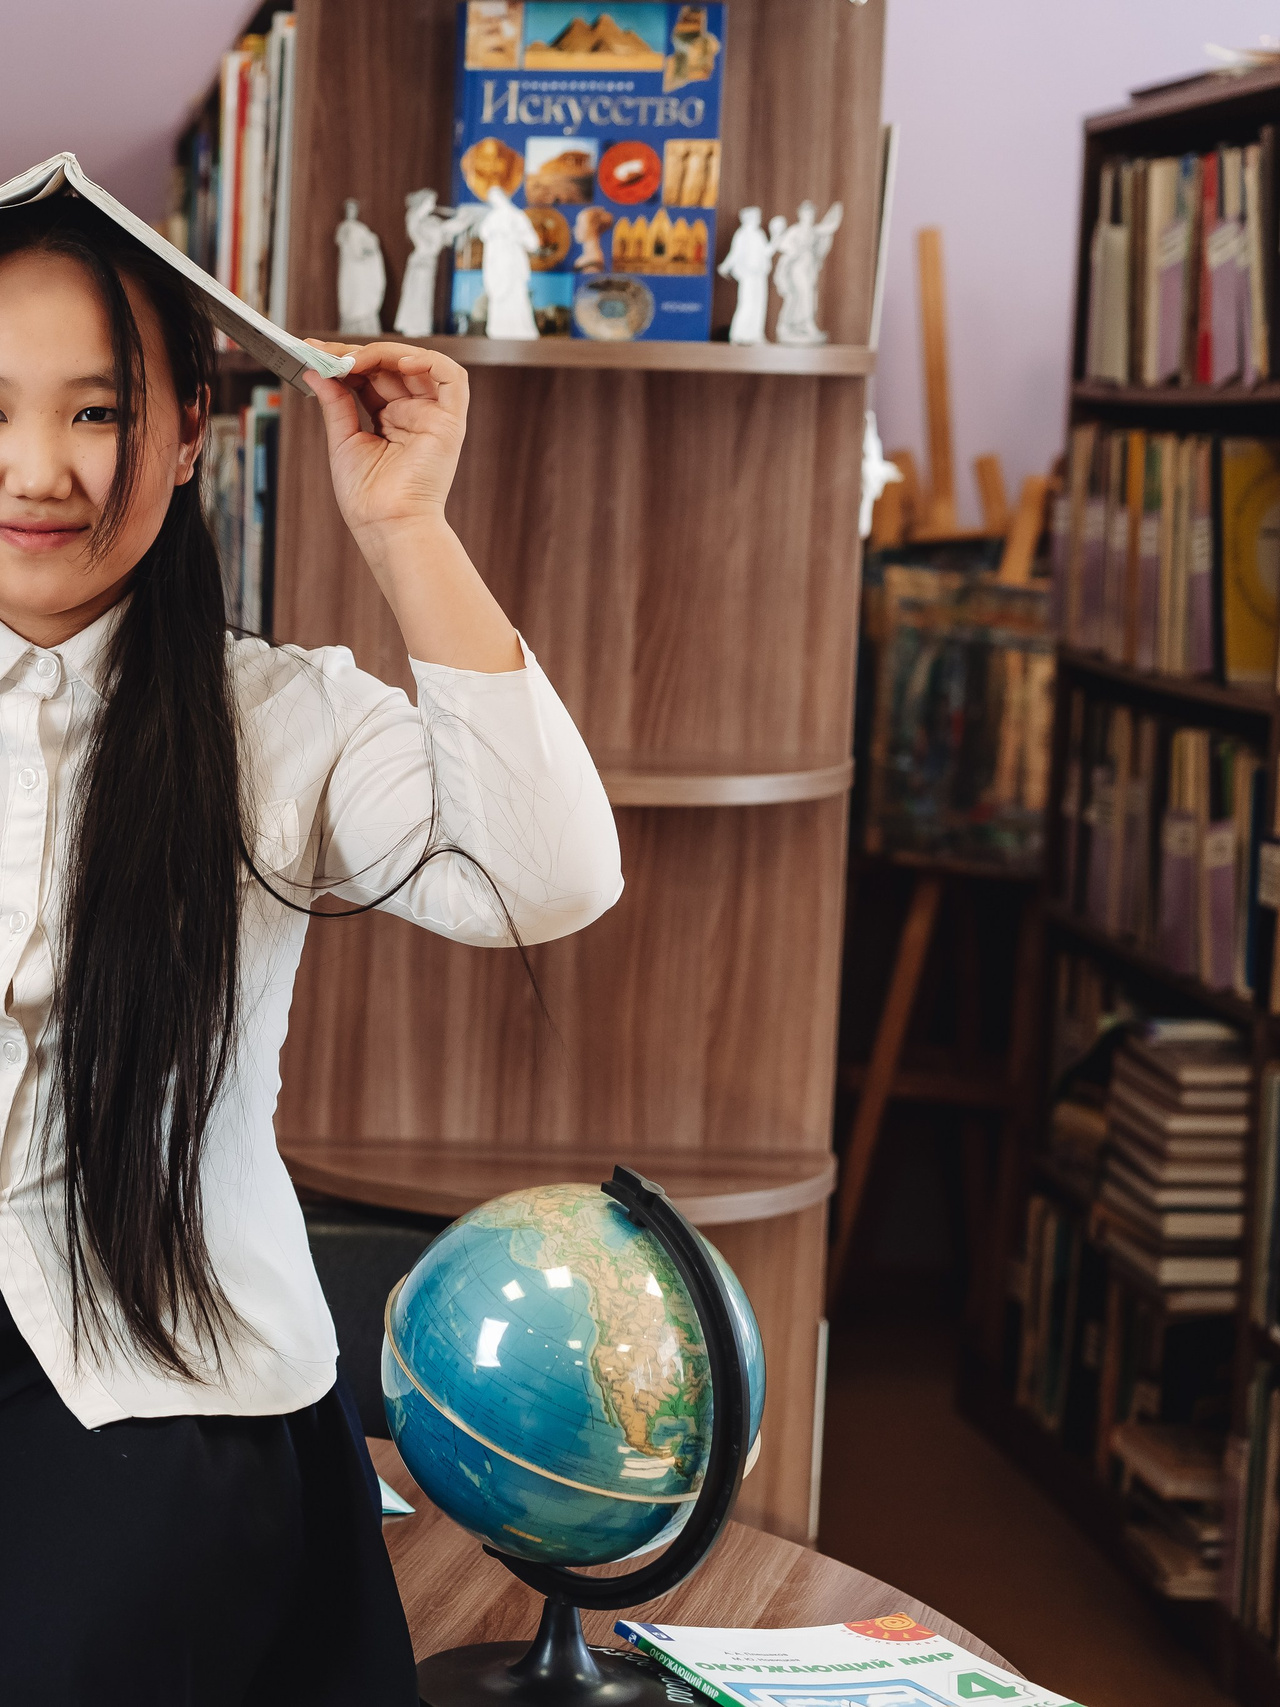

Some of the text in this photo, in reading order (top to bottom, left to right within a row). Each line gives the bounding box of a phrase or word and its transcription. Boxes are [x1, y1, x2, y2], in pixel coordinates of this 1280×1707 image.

[481, 79, 705, 135] Искусство
[649, 1648, 703, 1688] ОКРУЖАЮЩИЙ
[701, 1682, 720, 1699] МИР
[694, 1652, 955, 1673] ОКРУЖАЮЩИЙ МИР
[957, 1672, 1022, 1699] 4
